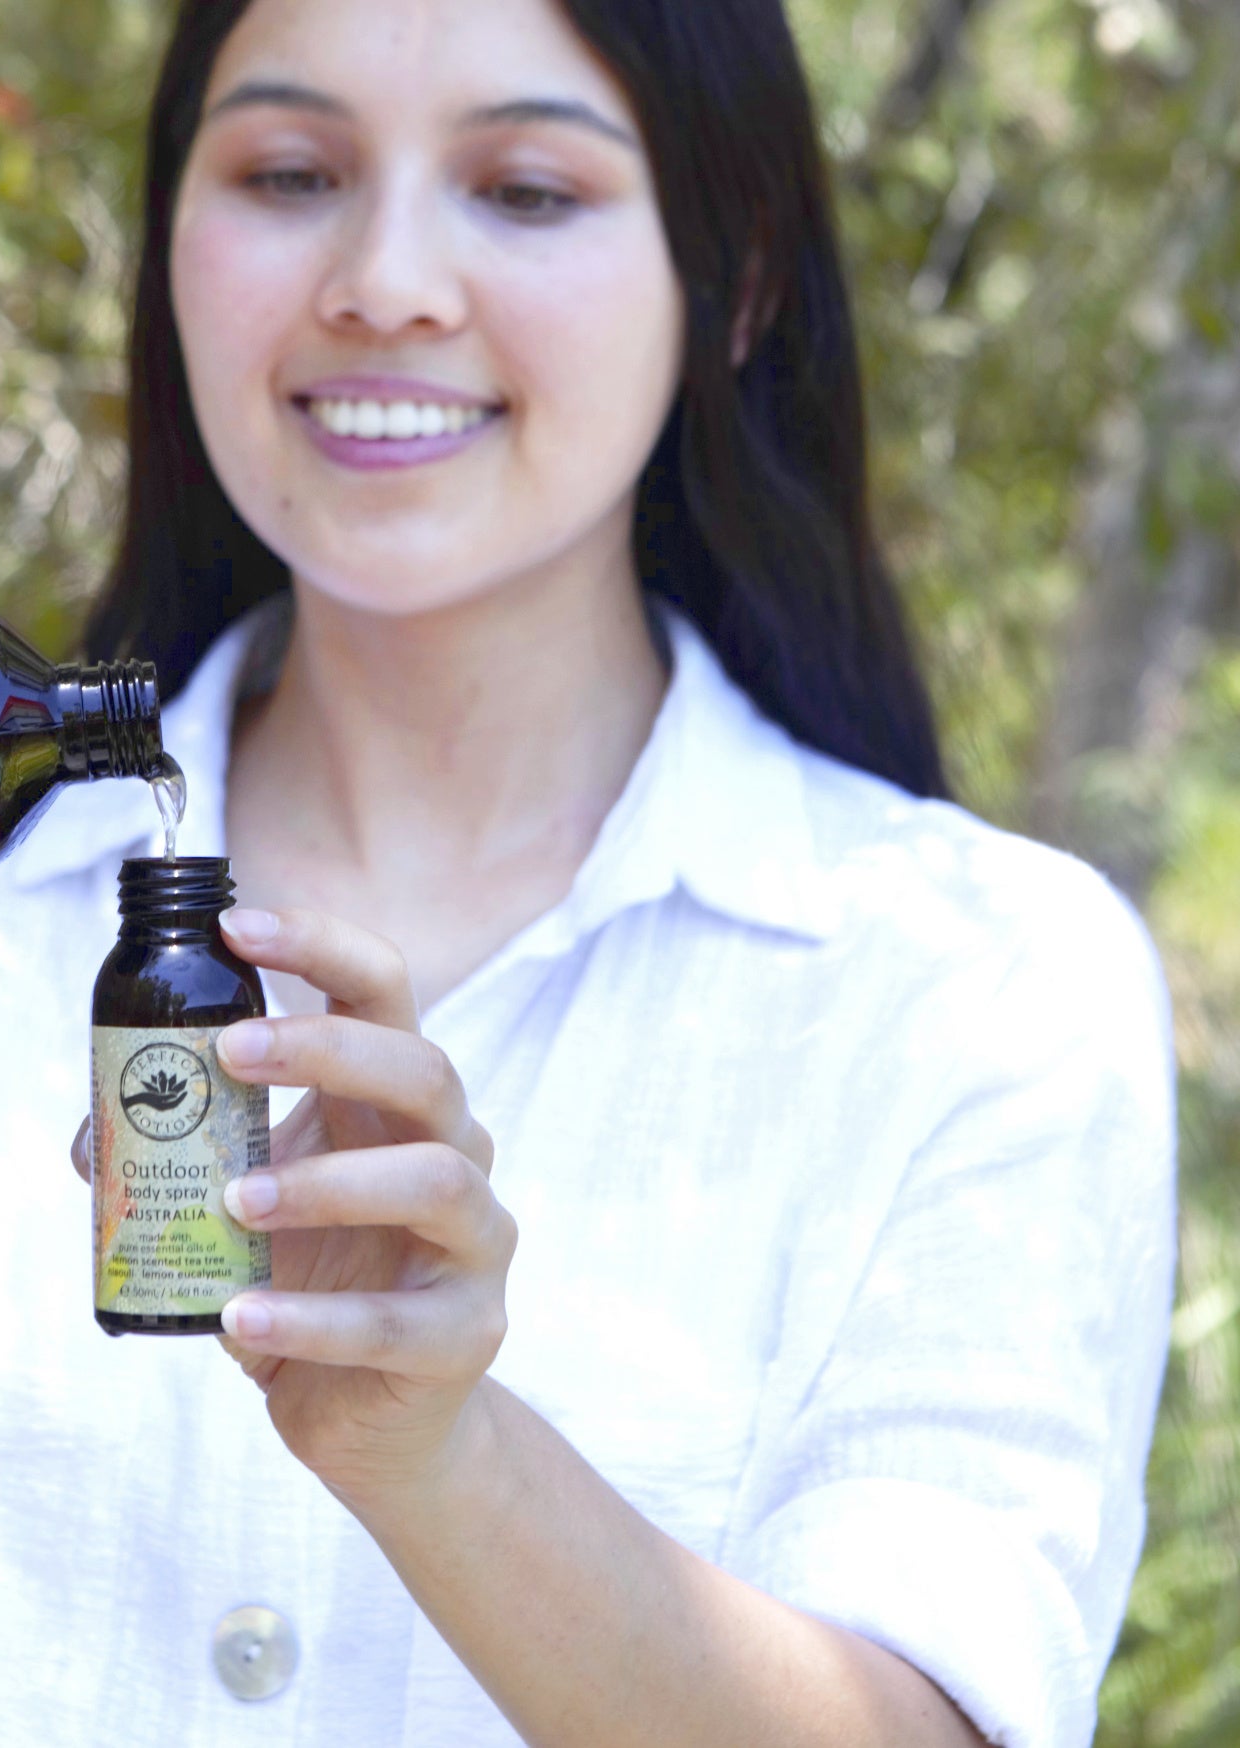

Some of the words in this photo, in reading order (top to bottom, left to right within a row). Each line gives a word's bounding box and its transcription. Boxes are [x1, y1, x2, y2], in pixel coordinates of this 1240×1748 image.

[130, 1051, 202, 1078] PERFECT
[132, 1108, 199, 1134] POTION
[122, 1159, 210, 1179] Outdoor
[124, 1183, 161, 1203] body
[165, 1187, 209, 1203] spray
[125, 1208, 207, 1222] AUSTRALIA
[139, 1232, 166, 1243] made
[169, 1231, 192, 1243] with
[140, 1243, 184, 1254] essential
[186, 1242, 204, 1254] oils
[206, 1240, 217, 1253] of
[112, 1254, 139, 1266] lemon
[141, 1256, 182, 1267] scented
[184, 1256, 202, 1267] tea
[204, 1256, 225, 1266] tree
[142, 1268, 175, 1279] lemon
[177, 1268, 233, 1280] eucalyptus
